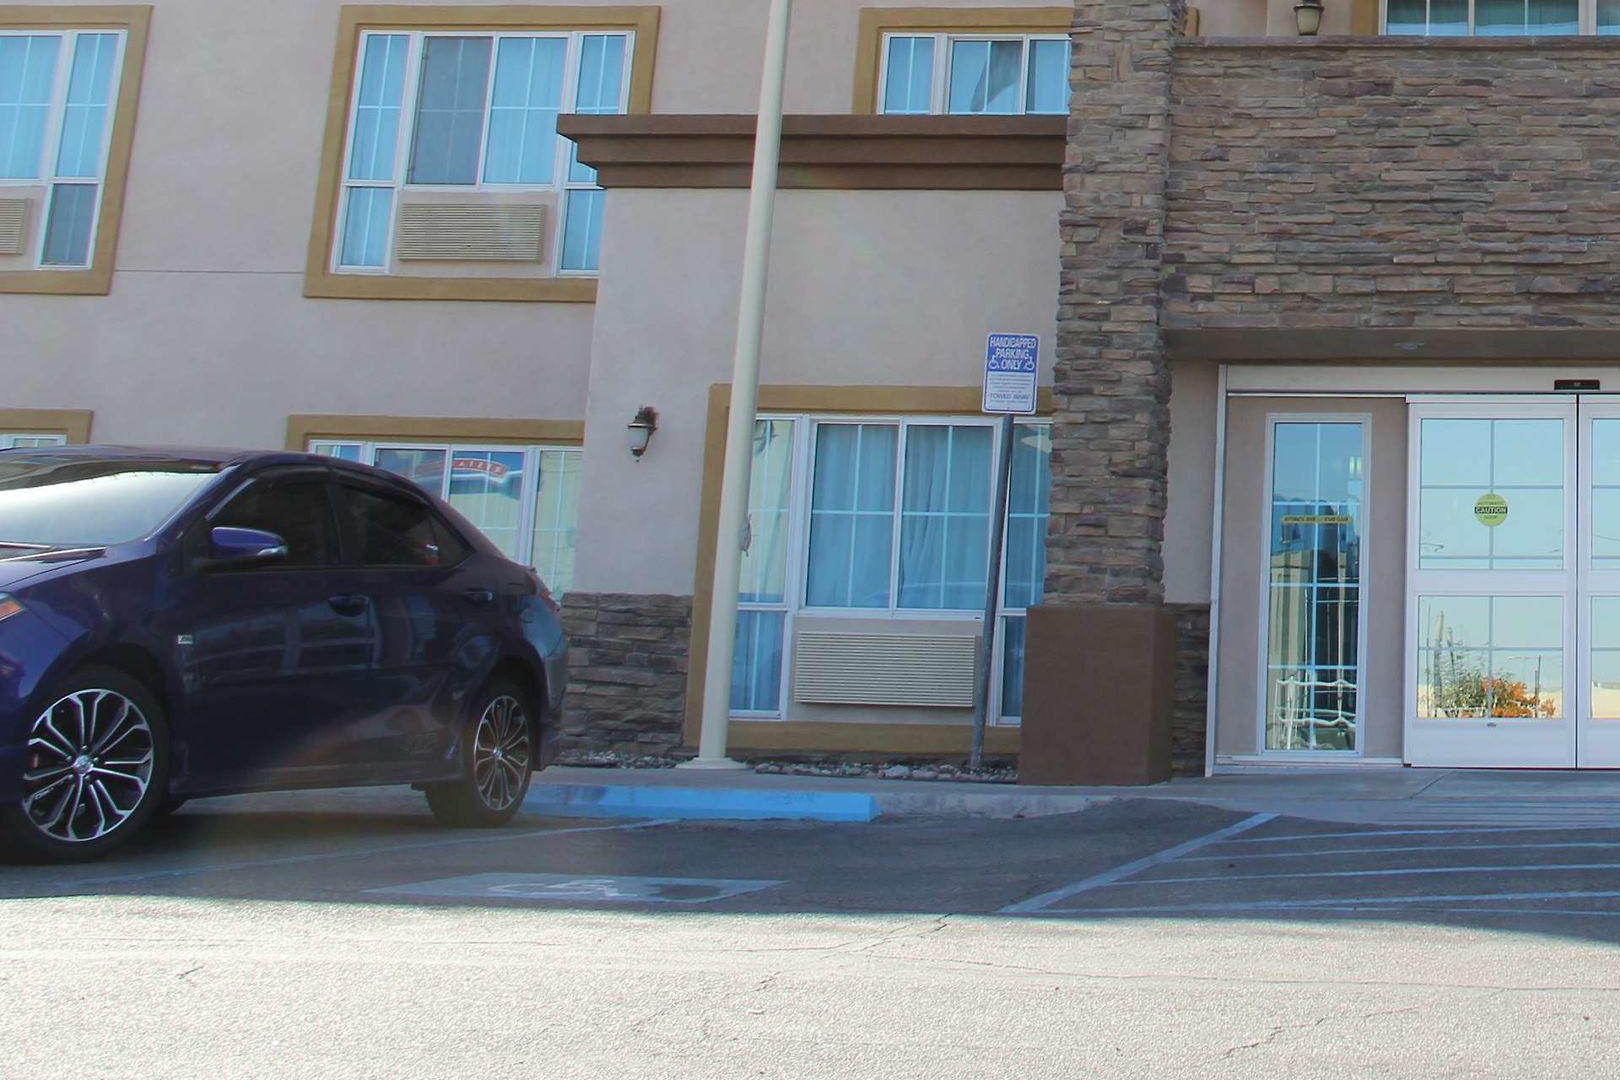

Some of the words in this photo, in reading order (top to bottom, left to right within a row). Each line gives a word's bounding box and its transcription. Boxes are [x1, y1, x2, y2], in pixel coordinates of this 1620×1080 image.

[990, 337, 1036, 348] HANDICAPPED
[995, 348, 1029, 359] PARKING
[1001, 359, 1022, 370] ONLY
